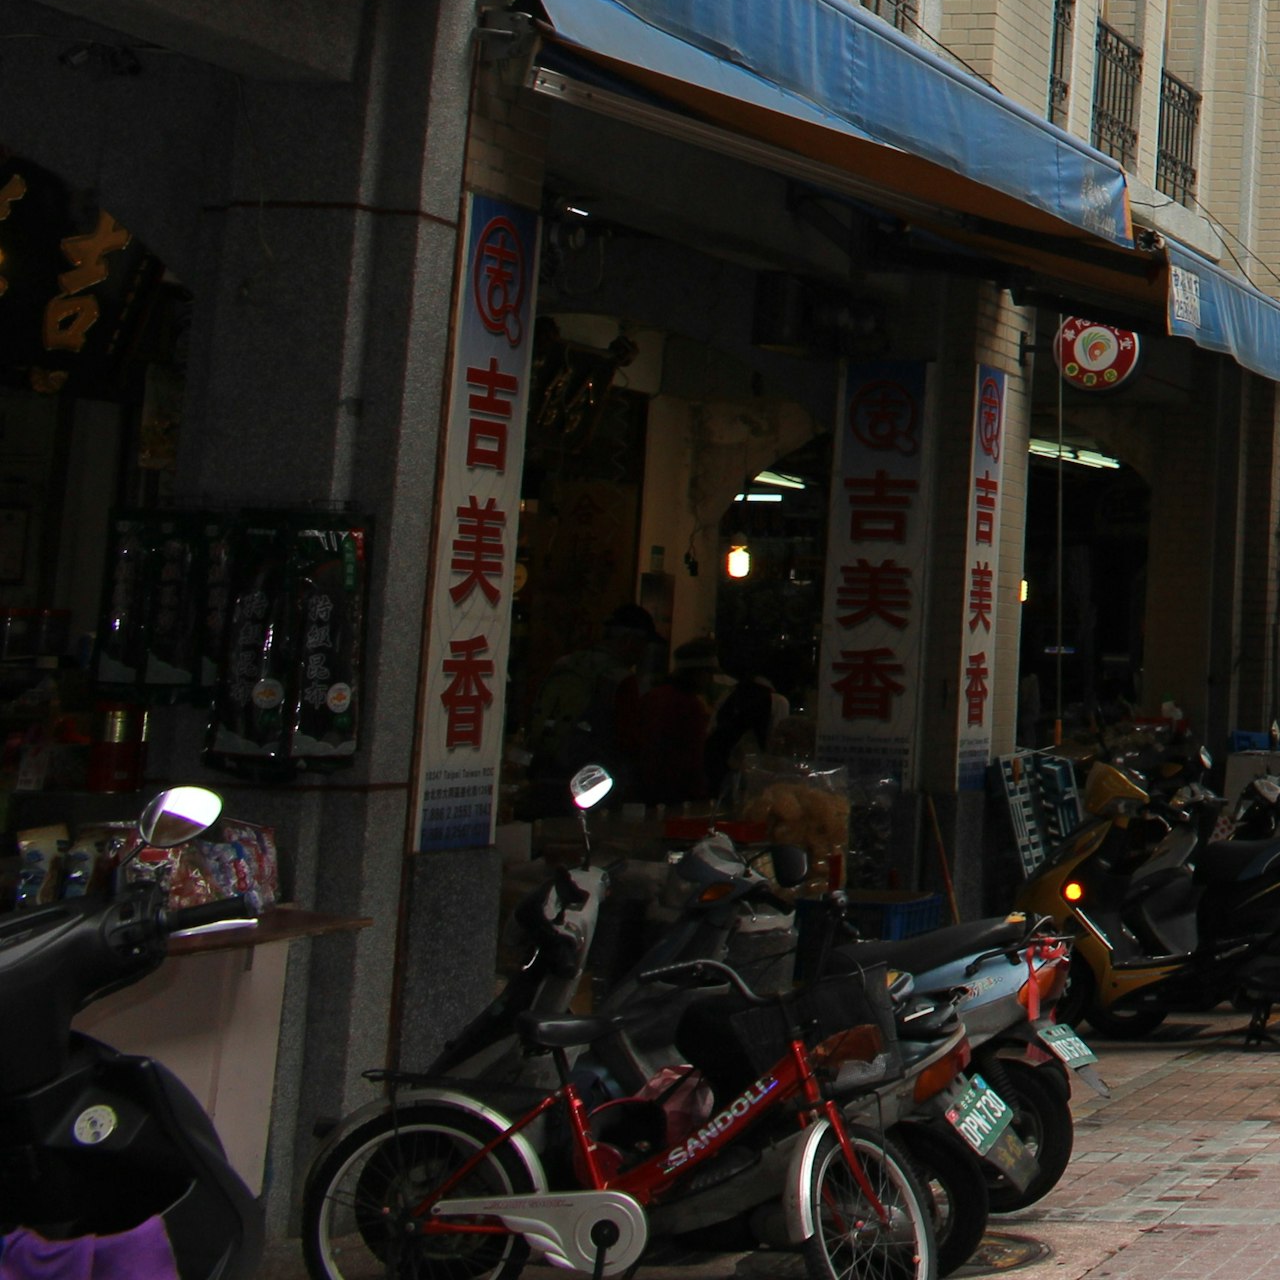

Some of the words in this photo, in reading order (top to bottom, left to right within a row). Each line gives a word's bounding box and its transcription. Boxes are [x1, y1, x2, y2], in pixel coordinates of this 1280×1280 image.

[440, 357, 519, 750] 吉美香
[830, 469, 919, 721] 吉美香
[964, 476, 998, 728] 吉美香
